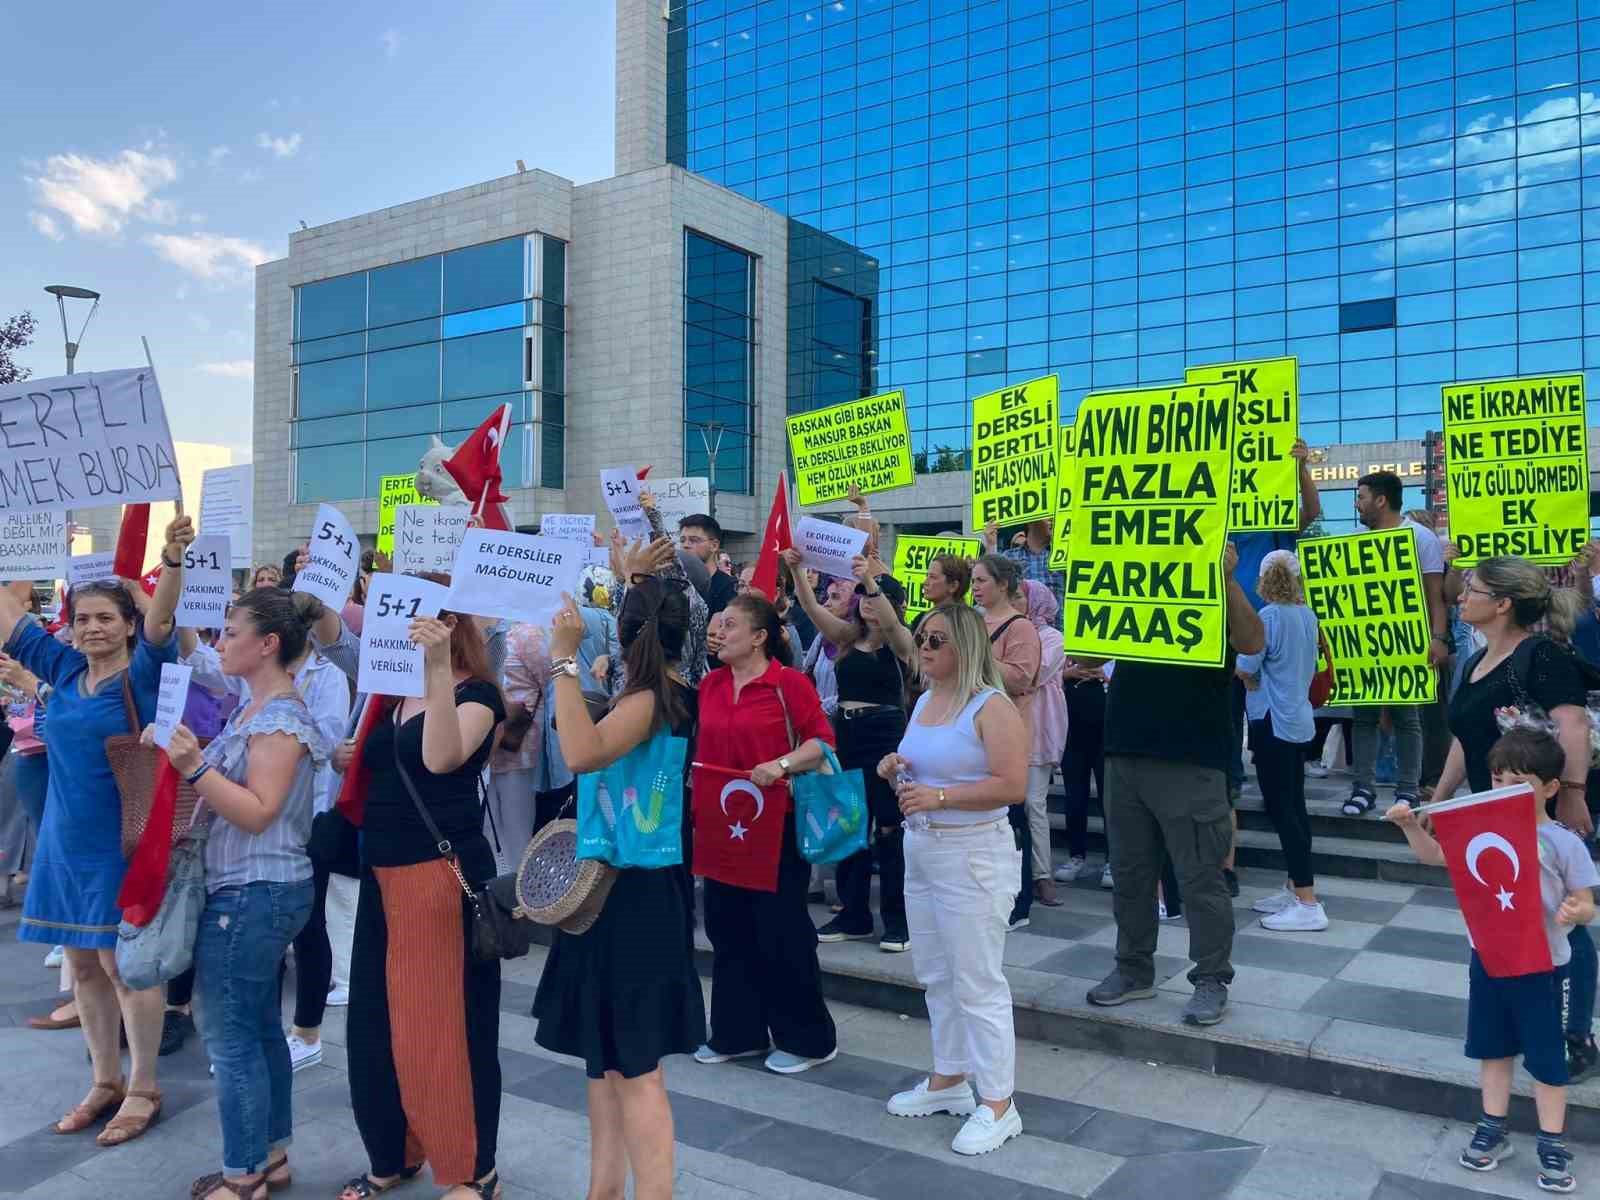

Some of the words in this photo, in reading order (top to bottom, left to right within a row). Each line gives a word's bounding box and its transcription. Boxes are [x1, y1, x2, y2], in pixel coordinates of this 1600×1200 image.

[792, 414, 831, 435] BAŞKAN
[834, 405, 855, 425] GİBİ
[857, 398, 900, 422] BAŞKAN
[1001, 386, 1027, 410] EK
[1449, 394, 1474, 421] NE
[1480, 381, 1580, 418] İKRAMİYE
[804, 428, 847, 449] MANSUR
[849, 417, 891, 439] BAŞKAN
[977, 400, 1052, 440] DERSLİ
[1077, 405, 1141, 458] AYNI
[1146, 388, 1229, 454] BİRİM
[797, 457, 808, 470] EK
[810, 445, 858, 467] DERSLİLER
[861, 434, 905, 456] BEKLİYOR
[978, 424, 1052, 463] DERTLİ
[1450, 432, 1483, 460] NE
[1490, 421, 1582, 457] TEDİYE
[79, 443, 181, 496] BURDA
[606, 480, 632, 496] 5+1
[806, 470, 826, 487] HEM
[827, 464, 857, 482] ÖZLÜK
[859, 455, 900, 473] HAKLARI
[815, 483, 836, 499] HEM
[871, 471, 893, 486] ZAM!
[974, 451, 1056, 495] ENFLASYONLA
[1083, 461, 1217, 501] FAZLA
[1452, 464, 1481, 499] YÜZ
[1485, 459, 1583, 497] GÜLDÜRMEDİ
[402, 509, 424, 528] Ne
[983, 481, 1048, 523] ERİDİ
[1502, 499, 1537, 525] EK
[317, 521, 353, 560] 5+1
[401, 530, 424, 545] Ne
[1090, 508, 1205, 546] EMEK
[1456, 524, 1585, 558] DERSLİYE
[185, 551, 221, 570] 5+1
[479, 542, 495, 554] EK
[497, 544, 562, 565] DERSLİLER
[1304, 535, 1412, 579] EK'LEYE
[475, 563, 554, 587] MAĞDURUZ
[1067, 560, 1217, 600] FARKLI
[377, 593, 421, 618] 5+1
[1309, 579, 1419, 620] EK'LEYE
[369, 638, 417, 651] HAKKIMIZ
[1074, 604, 1204, 654] MAAŞ
[1365, 619, 1425, 657] SONU
[370, 657, 414, 673] VERİLSİN
[1328, 659, 1429, 701] ELMİYOR
